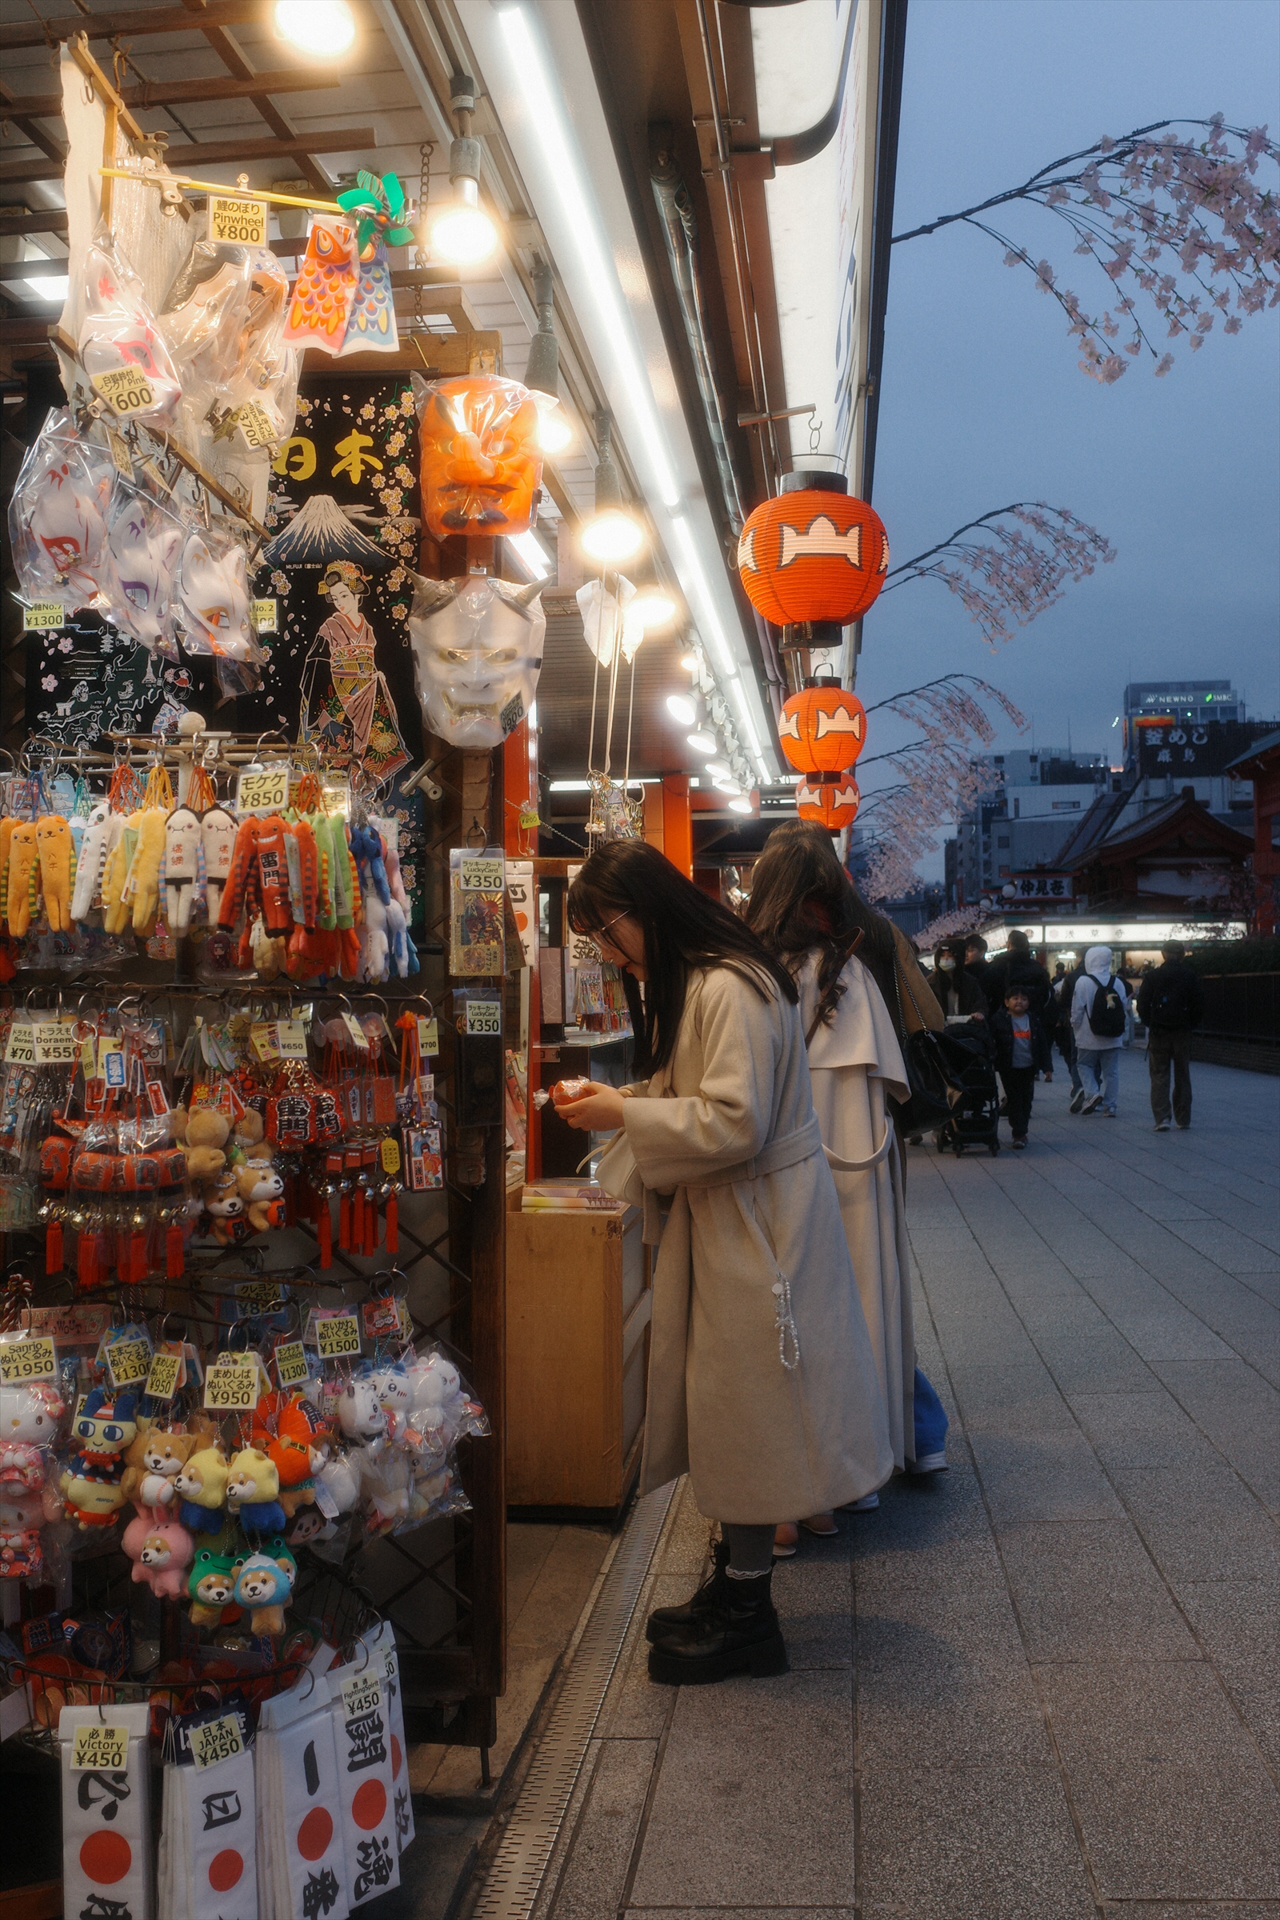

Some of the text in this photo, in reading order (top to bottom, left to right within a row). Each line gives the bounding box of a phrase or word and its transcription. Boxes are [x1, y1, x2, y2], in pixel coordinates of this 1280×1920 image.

[217, 199, 260, 215] 鯉のぼり
[213, 212, 264, 227] Pinwheel
[217, 224, 260, 242] ¥800
[127, 375, 147, 387] Pink
[240, 408, 260, 446] 3700
[273, 428, 384, 485] 日本
[25, 614, 63, 627] ¥1300
[1158, 694, 1232, 704] NEWNO SMBC
[1145, 726, 1208, 746] 釜めし
[241, 772, 287, 791] モケケ
[240, 789, 285, 809] ¥850
[260, 850, 281, 888] 雷門
[462, 860, 503, 869] ラッキーカード
[462, 874, 503, 889] ¥350
[468, 1004, 499, 1012] ラッキーカード
[12, 1028, 33, 1038] ドラえも
[39, 1026, 72, 1037] ドラえも
[468, 1019, 500, 1033] ¥350
[13, 1036, 34, 1045] Dorae
[36, 1036, 74, 1044] Doraem
[281, 1042, 304, 1051] ¥650
[420, 1041, 437, 1050] ¥700
[10, 1046, 34, 1061] ¥70
[276, 1096, 311, 1141] 雷門
[240, 1282, 276, 1295] クレヨン
[247, 1289, 281, 1300] ちゃん
[321, 1319, 355, 1333] ちいかわ
[319, 1328, 358, 1341] ぬいぐるみ
[8, 1341, 43, 1355] Sanrio
[107, 1340, 149, 1359] たまごっち
[319, 1338, 359, 1355] ¥1500
[0, 1348, 53, 1365] ぬいぐるみ
[110, 1348, 151, 1368] ぬいぐるみ
[155, 1356, 177, 1369] まめしば
[2, 1359, 55, 1379] ¥1950
[114, 1361, 152, 1382] ¥1300
[151, 1367, 176, 1381] ぬいぐるみ
[213, 1368, 252, 1380] まめしば
[280, 1362, 307, 1381] ¥1300
[150, 1378, 172, 1394] ¥950
[206, 1380, 255, 1390] ぬいぐるみ
[210, 1391, 251, 1405] ¥950
[343, 1680, 380, 1699] FightingSpirit
[347, 1692, 380, 1715] ¥450
[88, 1727, 116, 1740] 必勝
[202, 1720, 226, 1739] 日本
[79, 1739, 123, 1752] Victory
[199, 1727, 234, 1751] JAPAN
[76, 1751, 123, 1767] ¥450
[198, 1738, 240, 1767] ¥450
